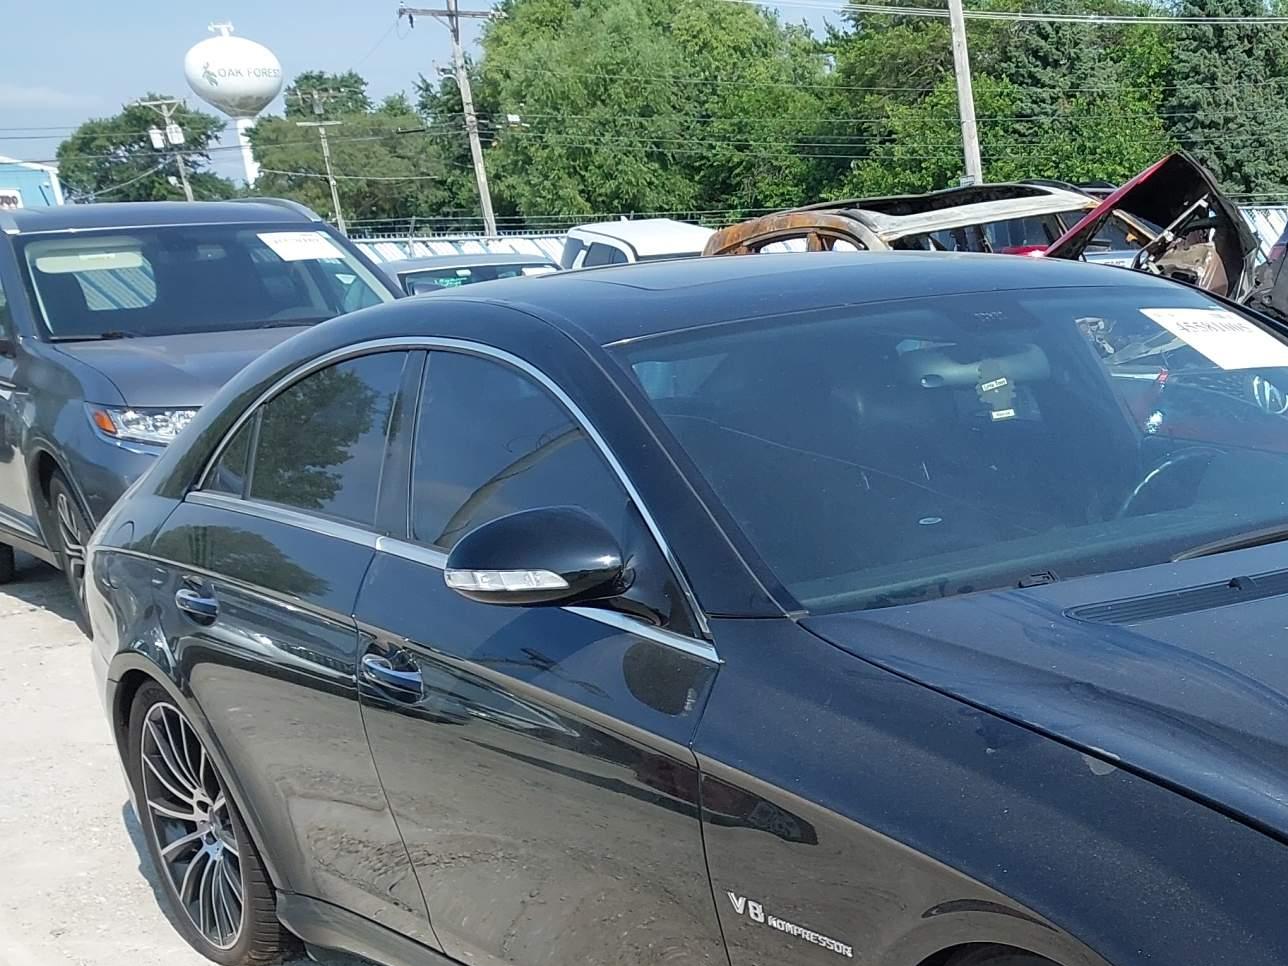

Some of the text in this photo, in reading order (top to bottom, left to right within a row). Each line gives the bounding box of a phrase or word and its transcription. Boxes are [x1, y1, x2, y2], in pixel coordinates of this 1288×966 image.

[217, 67, 244, 78] OAK
[727, 892, 853, 957] V8 KOMPRESSOR
